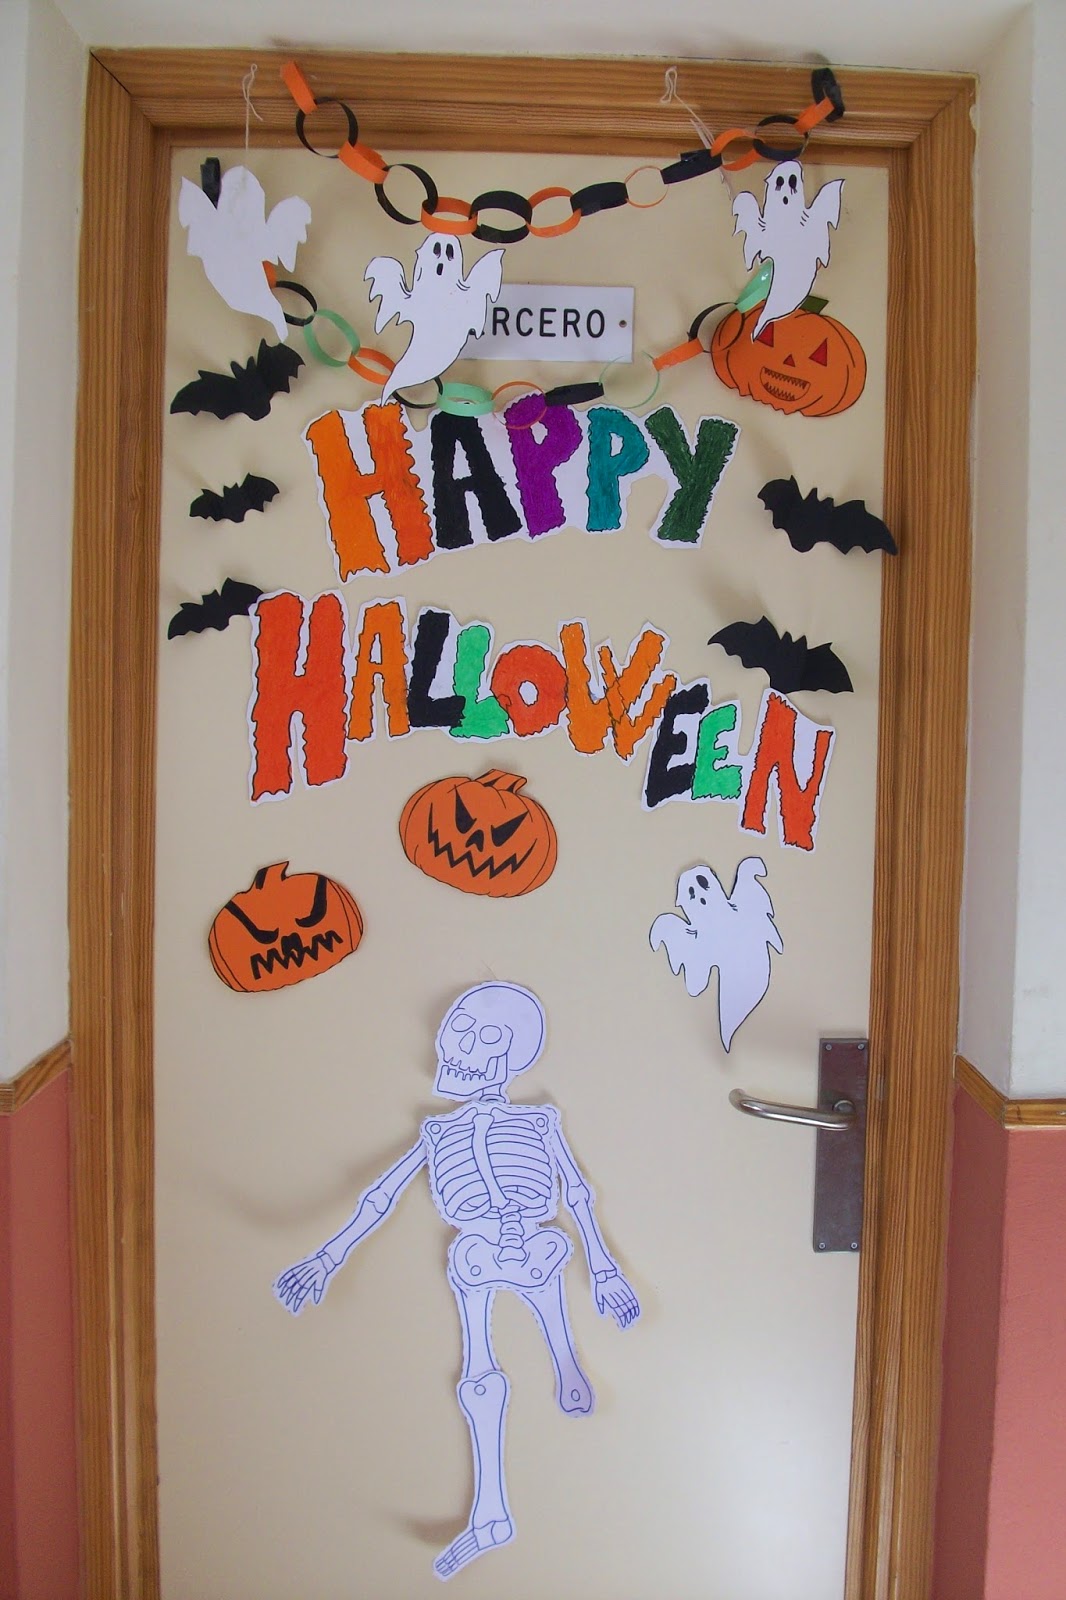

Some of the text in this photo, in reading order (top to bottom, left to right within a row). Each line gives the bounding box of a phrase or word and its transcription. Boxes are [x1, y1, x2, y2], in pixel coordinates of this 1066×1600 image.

[468, 307, 605, 338] RCERO
[306, 394, 738, 582] HAPPY
[251, 592, 833, 851] HALLOWEEN
